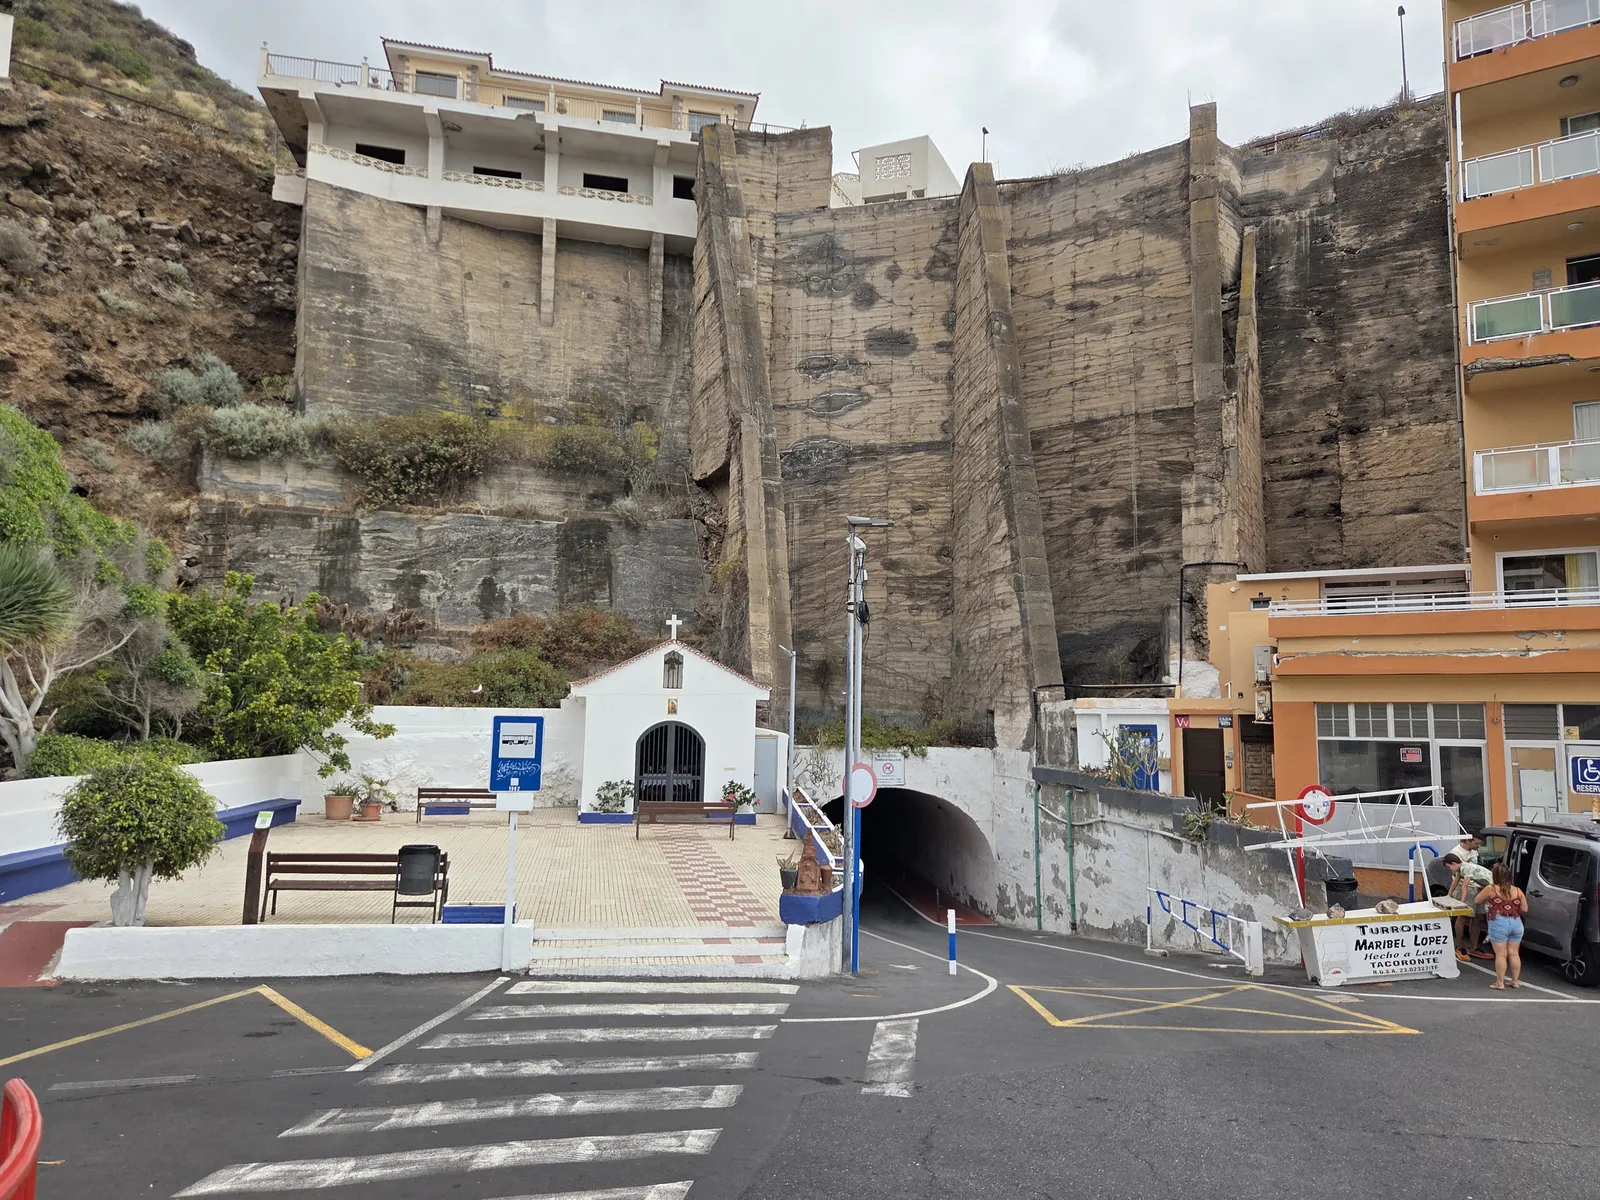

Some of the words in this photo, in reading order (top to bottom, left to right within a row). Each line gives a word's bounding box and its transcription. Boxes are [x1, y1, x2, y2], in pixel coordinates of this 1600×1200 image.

[1356, 922, 1442, 936] TURRONES
[1355, 939, 1406, 951] MARIBEL
[1414, 935, 1448, 946] LOPEZ
[1364, 950, 1400, 960] Hecho
[1370, 957, 1439, 969] TACORONTE
